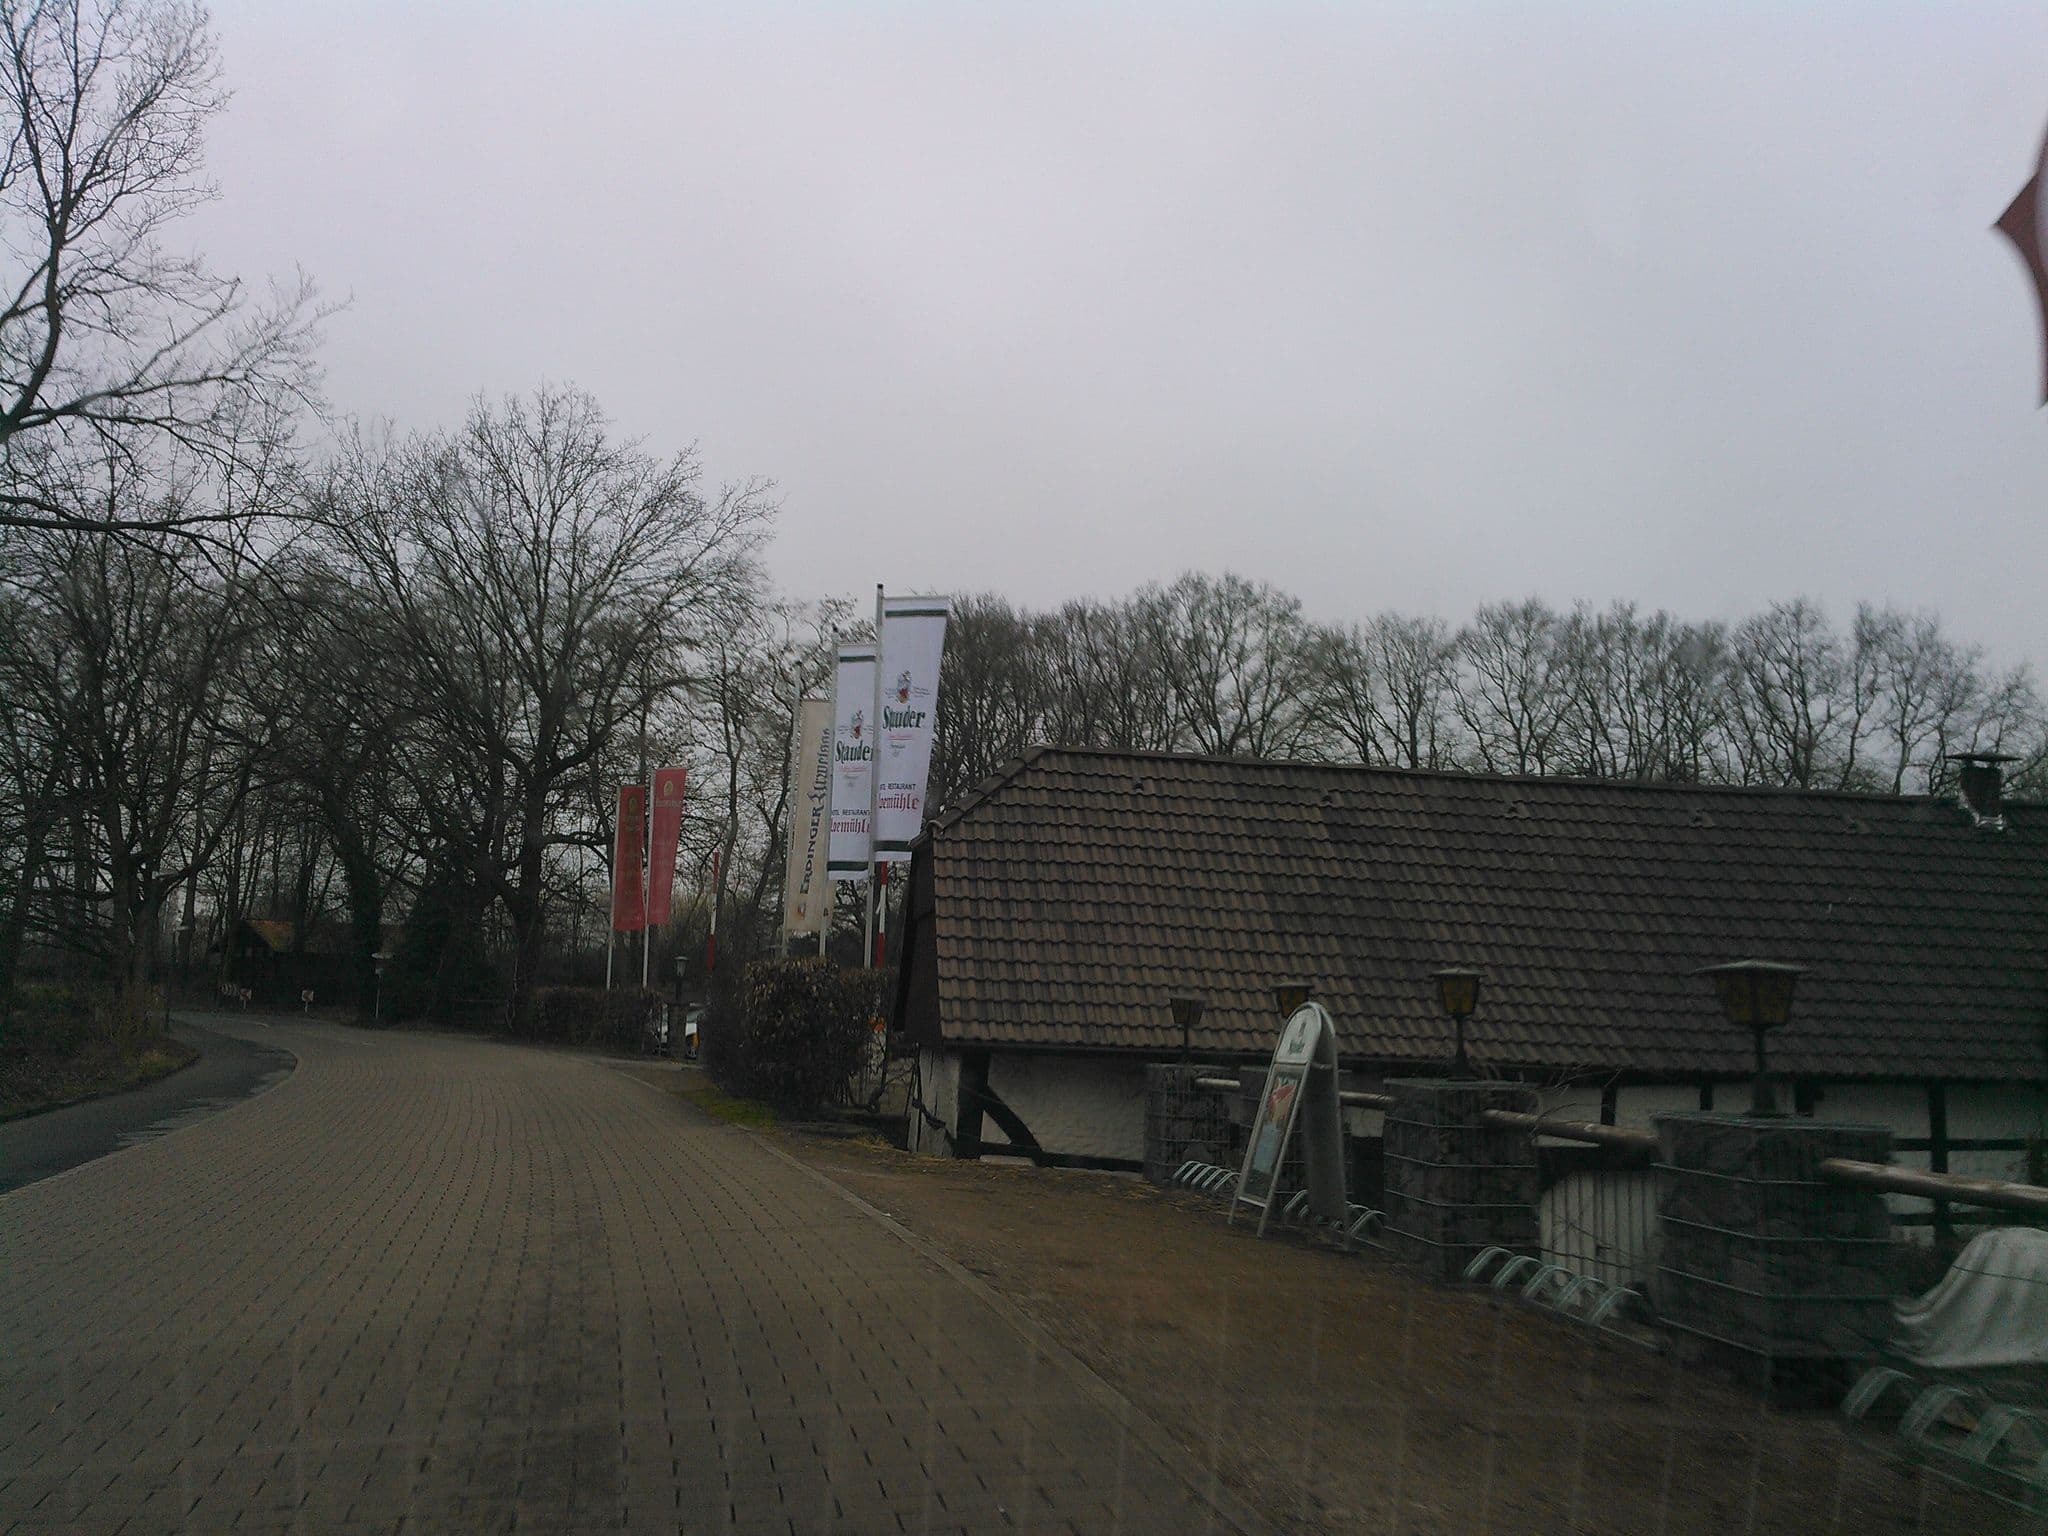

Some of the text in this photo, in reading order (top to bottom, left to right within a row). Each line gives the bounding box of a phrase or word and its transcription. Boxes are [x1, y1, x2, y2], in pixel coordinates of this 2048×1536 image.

[883, 705, 925, 731] Stauder
[888, 783, 916, 791] RESTAURANT
[800, 804, 824, 894] ERDINGER
